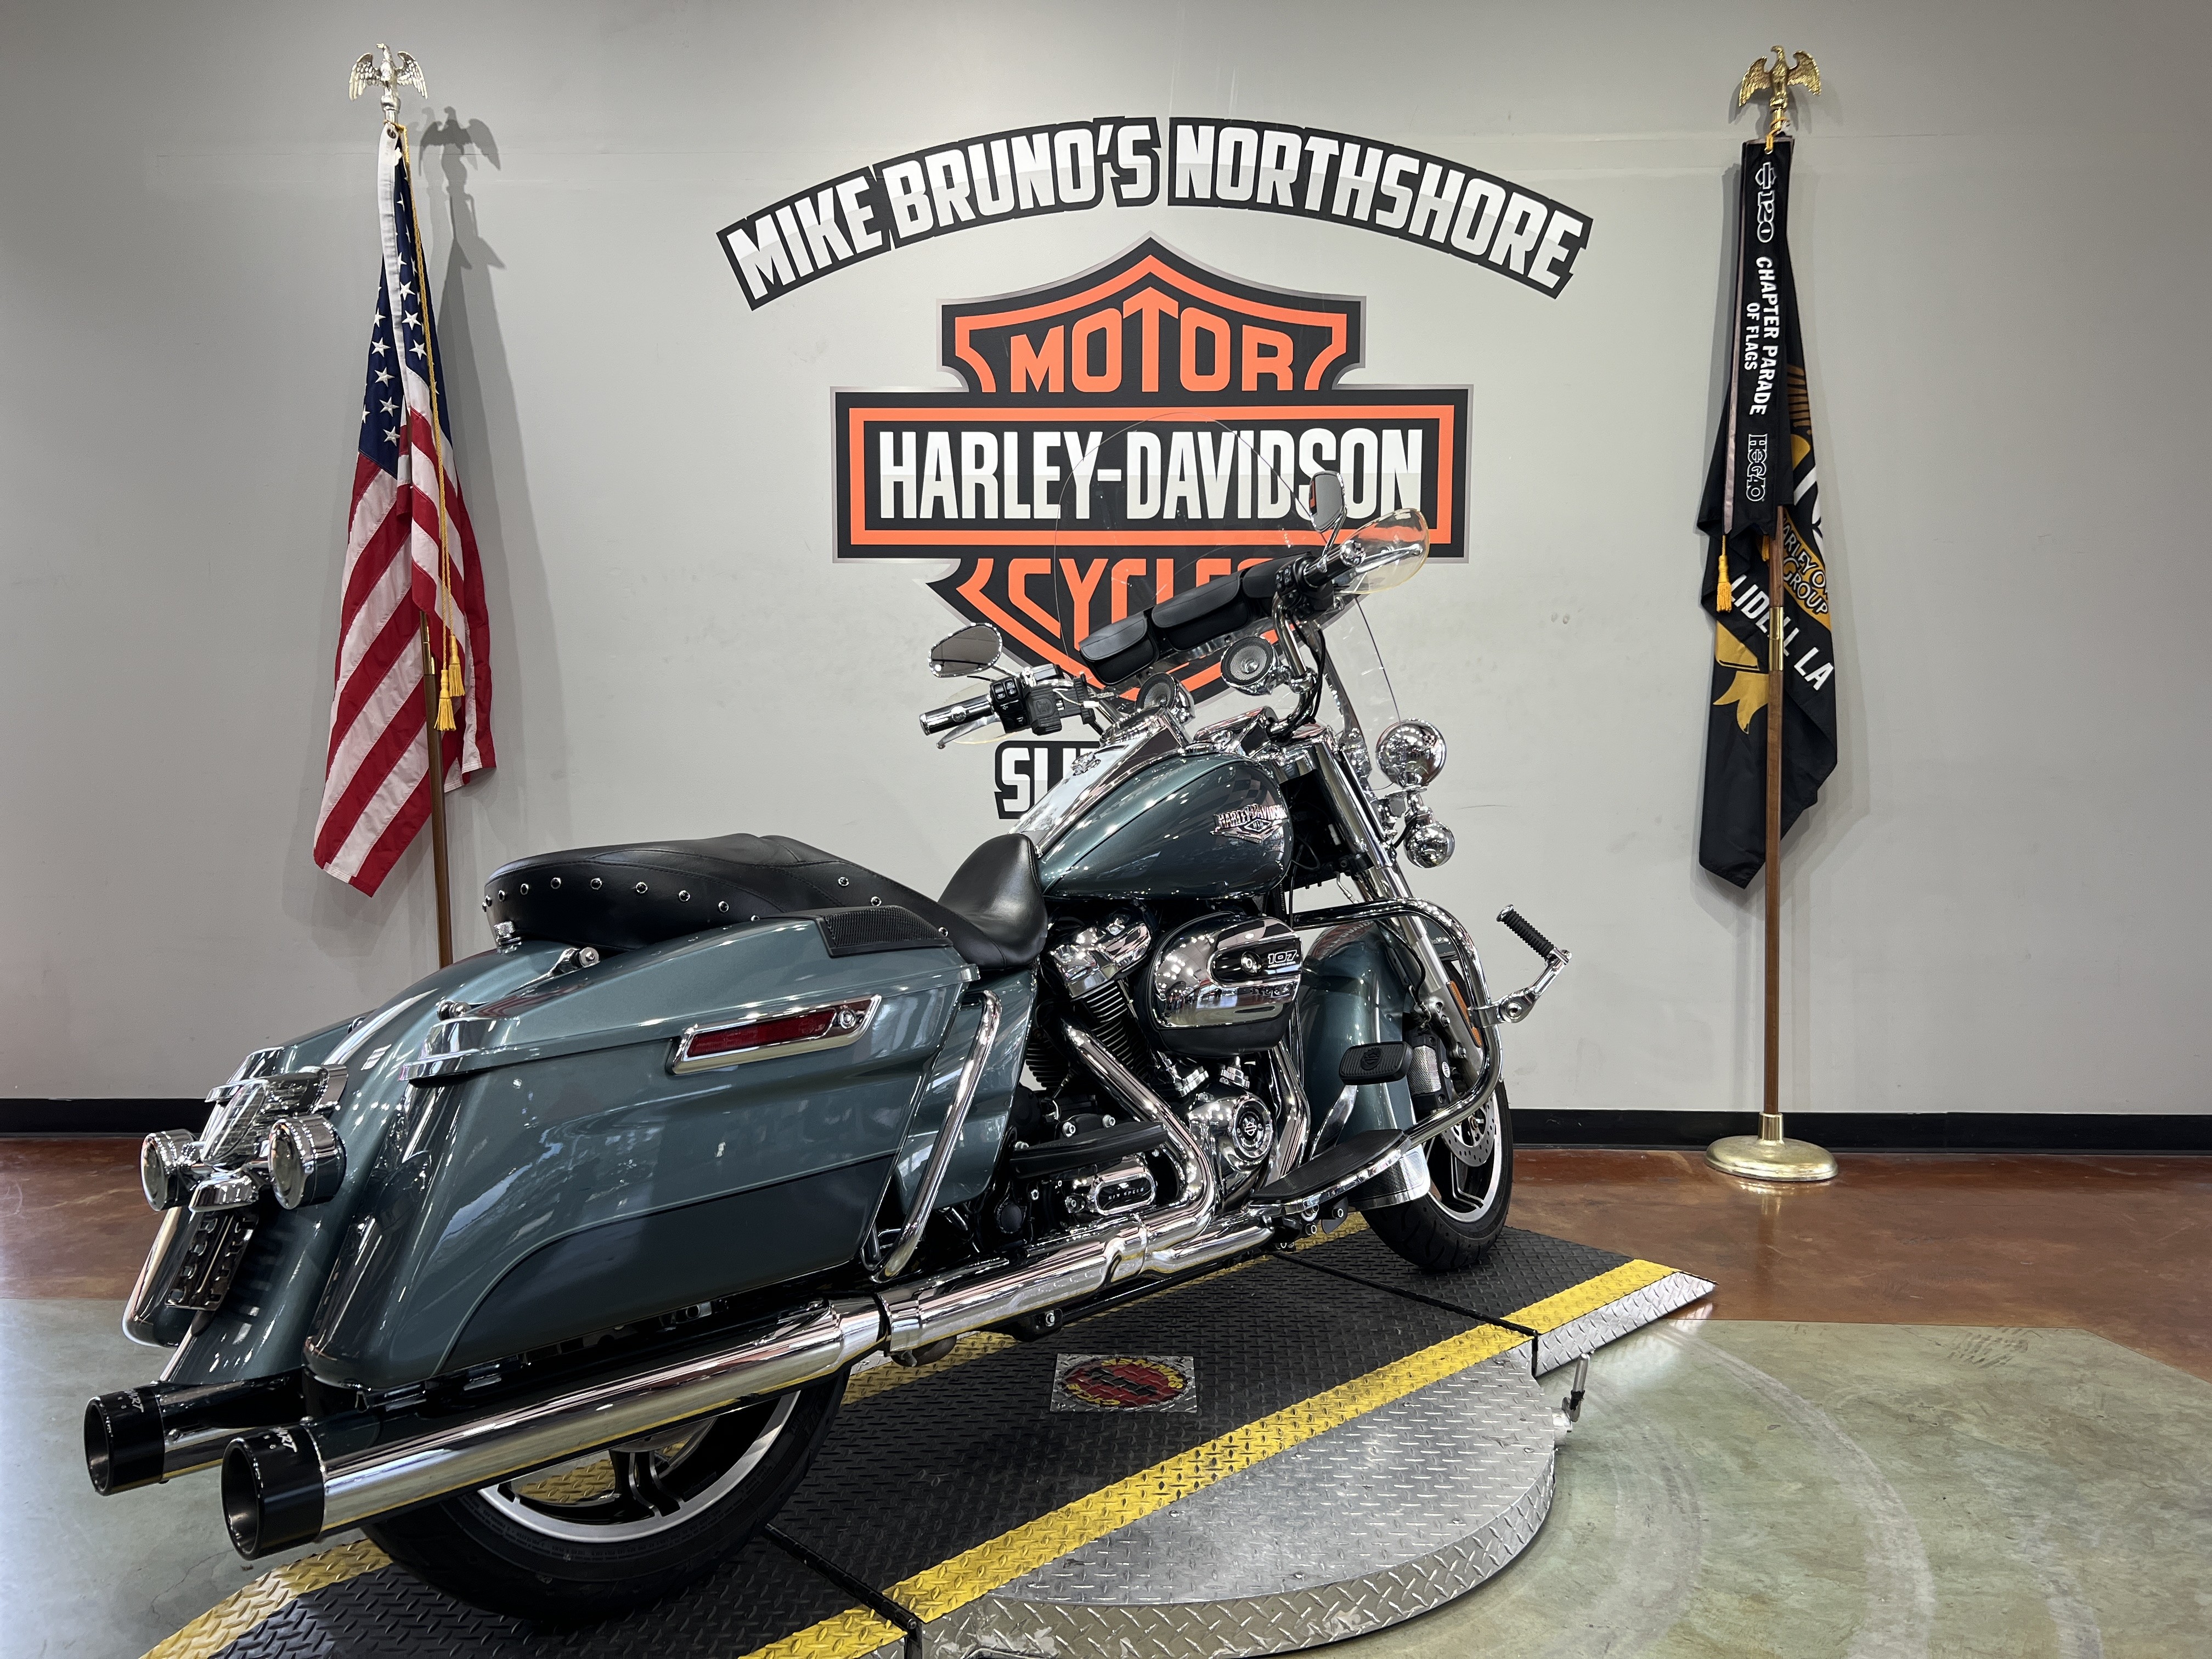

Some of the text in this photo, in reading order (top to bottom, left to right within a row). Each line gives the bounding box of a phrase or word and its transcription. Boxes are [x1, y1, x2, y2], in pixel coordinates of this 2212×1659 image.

[726, 123, 1584, 299] MIKE BRUNO'S NORTHSHORE
[1010, 286, 1294, 393] MOTOR
[1743, 302, 1760, 371] OF FLAGS
[1748, 256, 1780, 416] CHAPTER PARADE
[879, 429, 1423, 520] HARLEY-DAVIDSON
[1783, 517, 1816, 575] ARLEY
[1784, 557, 1829, 614] GROUP
[1794, 646, 1834, 691] LA
[1267, 949, 1297, 964] 107
[1124, 1187, 1144, 1196] SPEED
